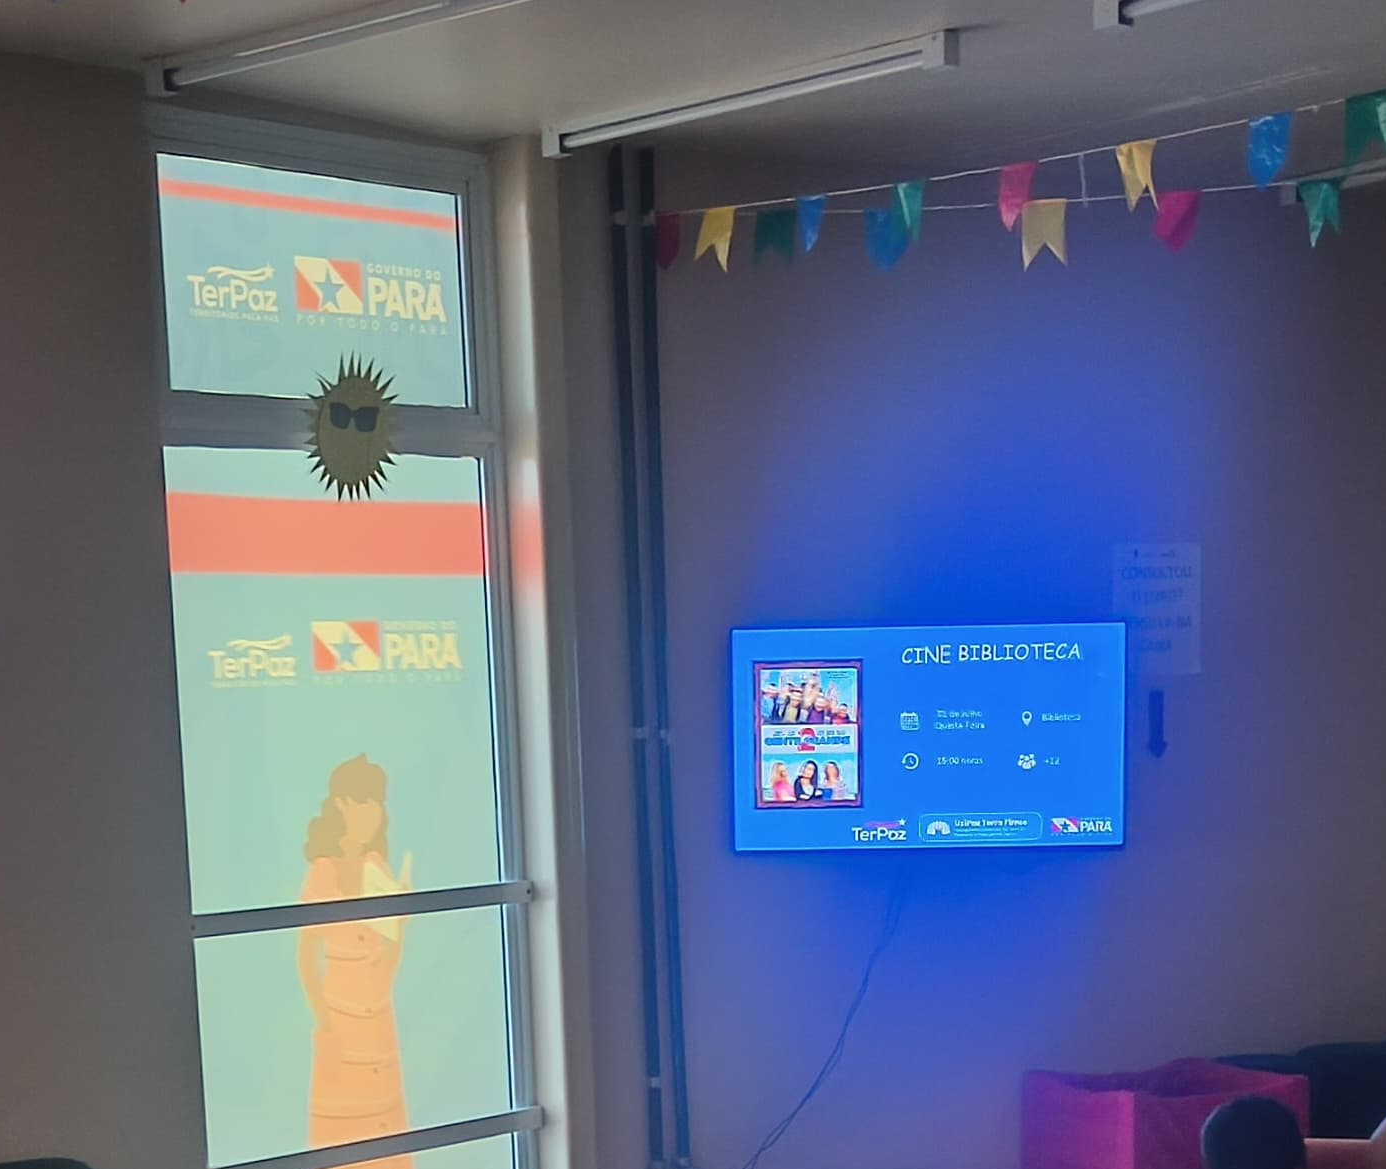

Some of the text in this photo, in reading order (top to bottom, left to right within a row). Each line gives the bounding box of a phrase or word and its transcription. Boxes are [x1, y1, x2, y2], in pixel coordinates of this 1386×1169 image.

[186, 274, 278, 312] TerPaz
[207, 650, 297, 679] TerPaz
[901, 642, 1081, 664] CINE BIBLIOTECA
